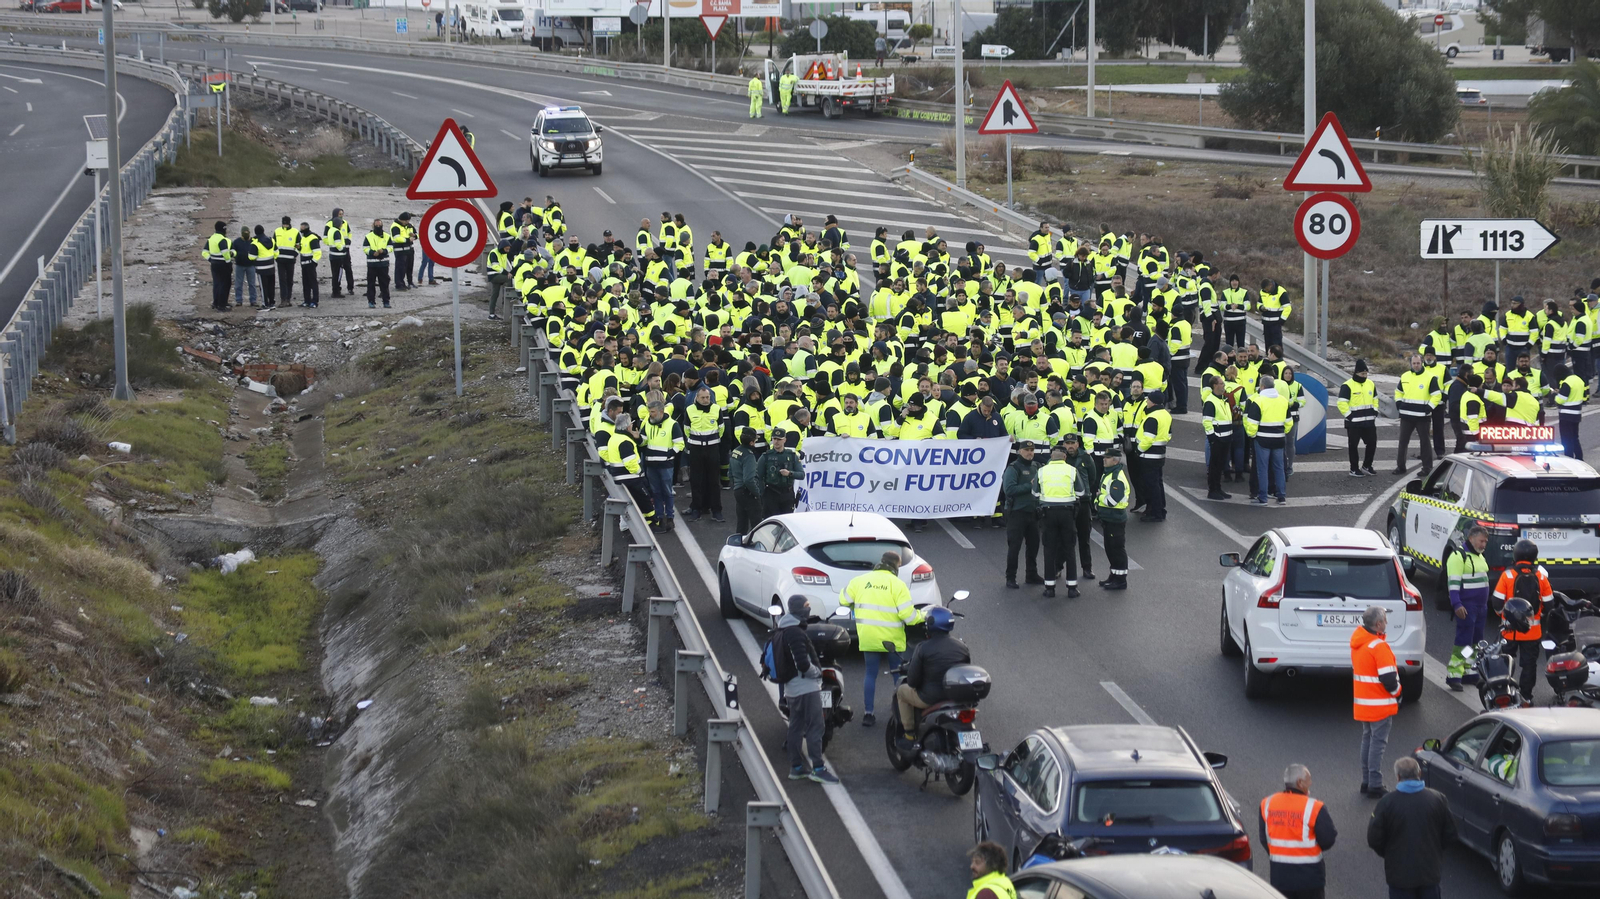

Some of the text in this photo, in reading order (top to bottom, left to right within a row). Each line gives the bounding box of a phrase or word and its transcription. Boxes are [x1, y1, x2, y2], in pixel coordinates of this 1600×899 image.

[538, 16, 563, 28] HTG
[434, 220, 473, 243] 80
[1309, 212, 1346, 235] 80
[1479, 230, 1525, 252] 1113
[1480, 426, 1554, 440] PRECAUCION
[804, 446, 986, 466] uestro CONVENIO
[806, 470, 997, 494] PLEO y el FUTURO
[815, 501, 828, 511] DE
[830, 501, 875, 513] EMPRESA
[877, 503, 931, 514] ACERINOX
[932, 502, 973, 514] EUROPA
[1323, 615, 1347, 625] 4854
